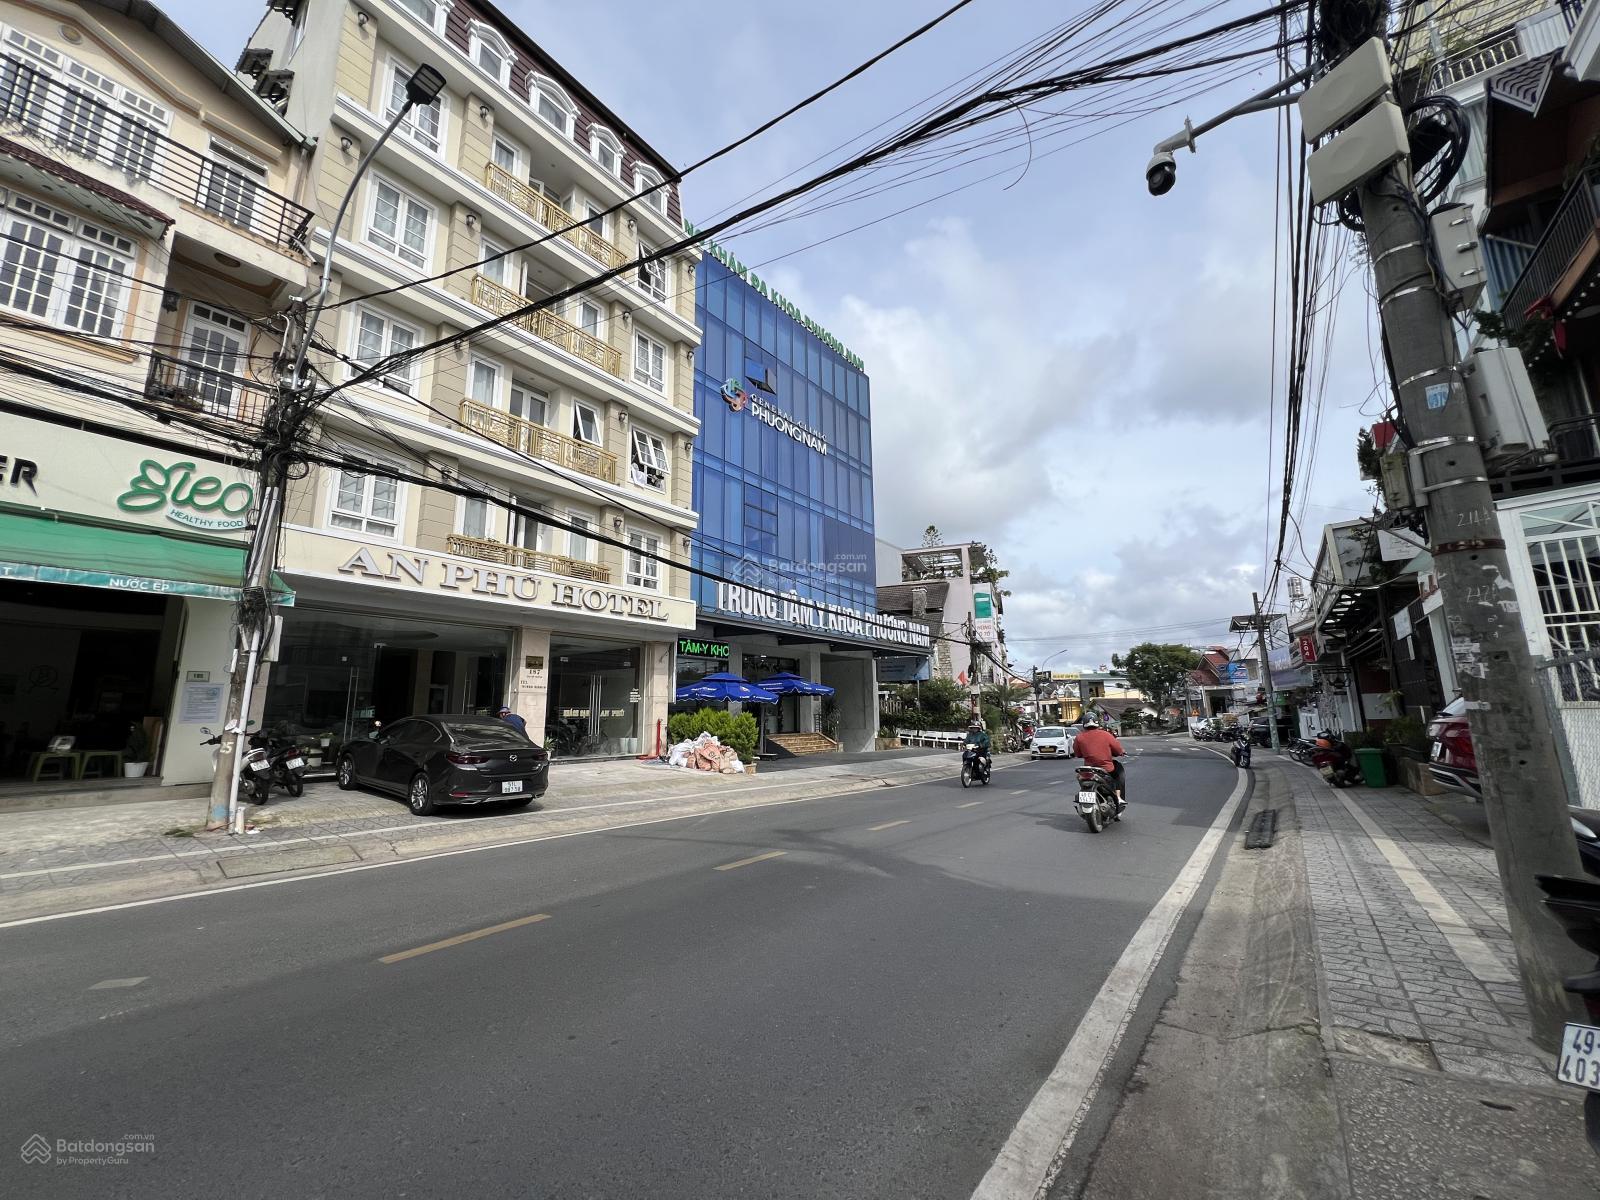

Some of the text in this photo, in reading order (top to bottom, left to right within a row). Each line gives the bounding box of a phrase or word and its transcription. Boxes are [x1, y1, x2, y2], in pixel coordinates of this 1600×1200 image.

[709, 239, 748, 281] KHÁM
[770, 288, 802, 324] KHOA
[845, 347, 865, 373] NAM
[170, 509, 244, 528] HEALTHY FOOD
[338, 547, 429, 586] AN
[552, 582, 669, 621] HOTEL
[716, 580, 777, 619] TRUNG
[780, 588, 812, 627] TÂM
[828, 603, 863, 635] KHOA
[909, 621, 930, 647] NAM
